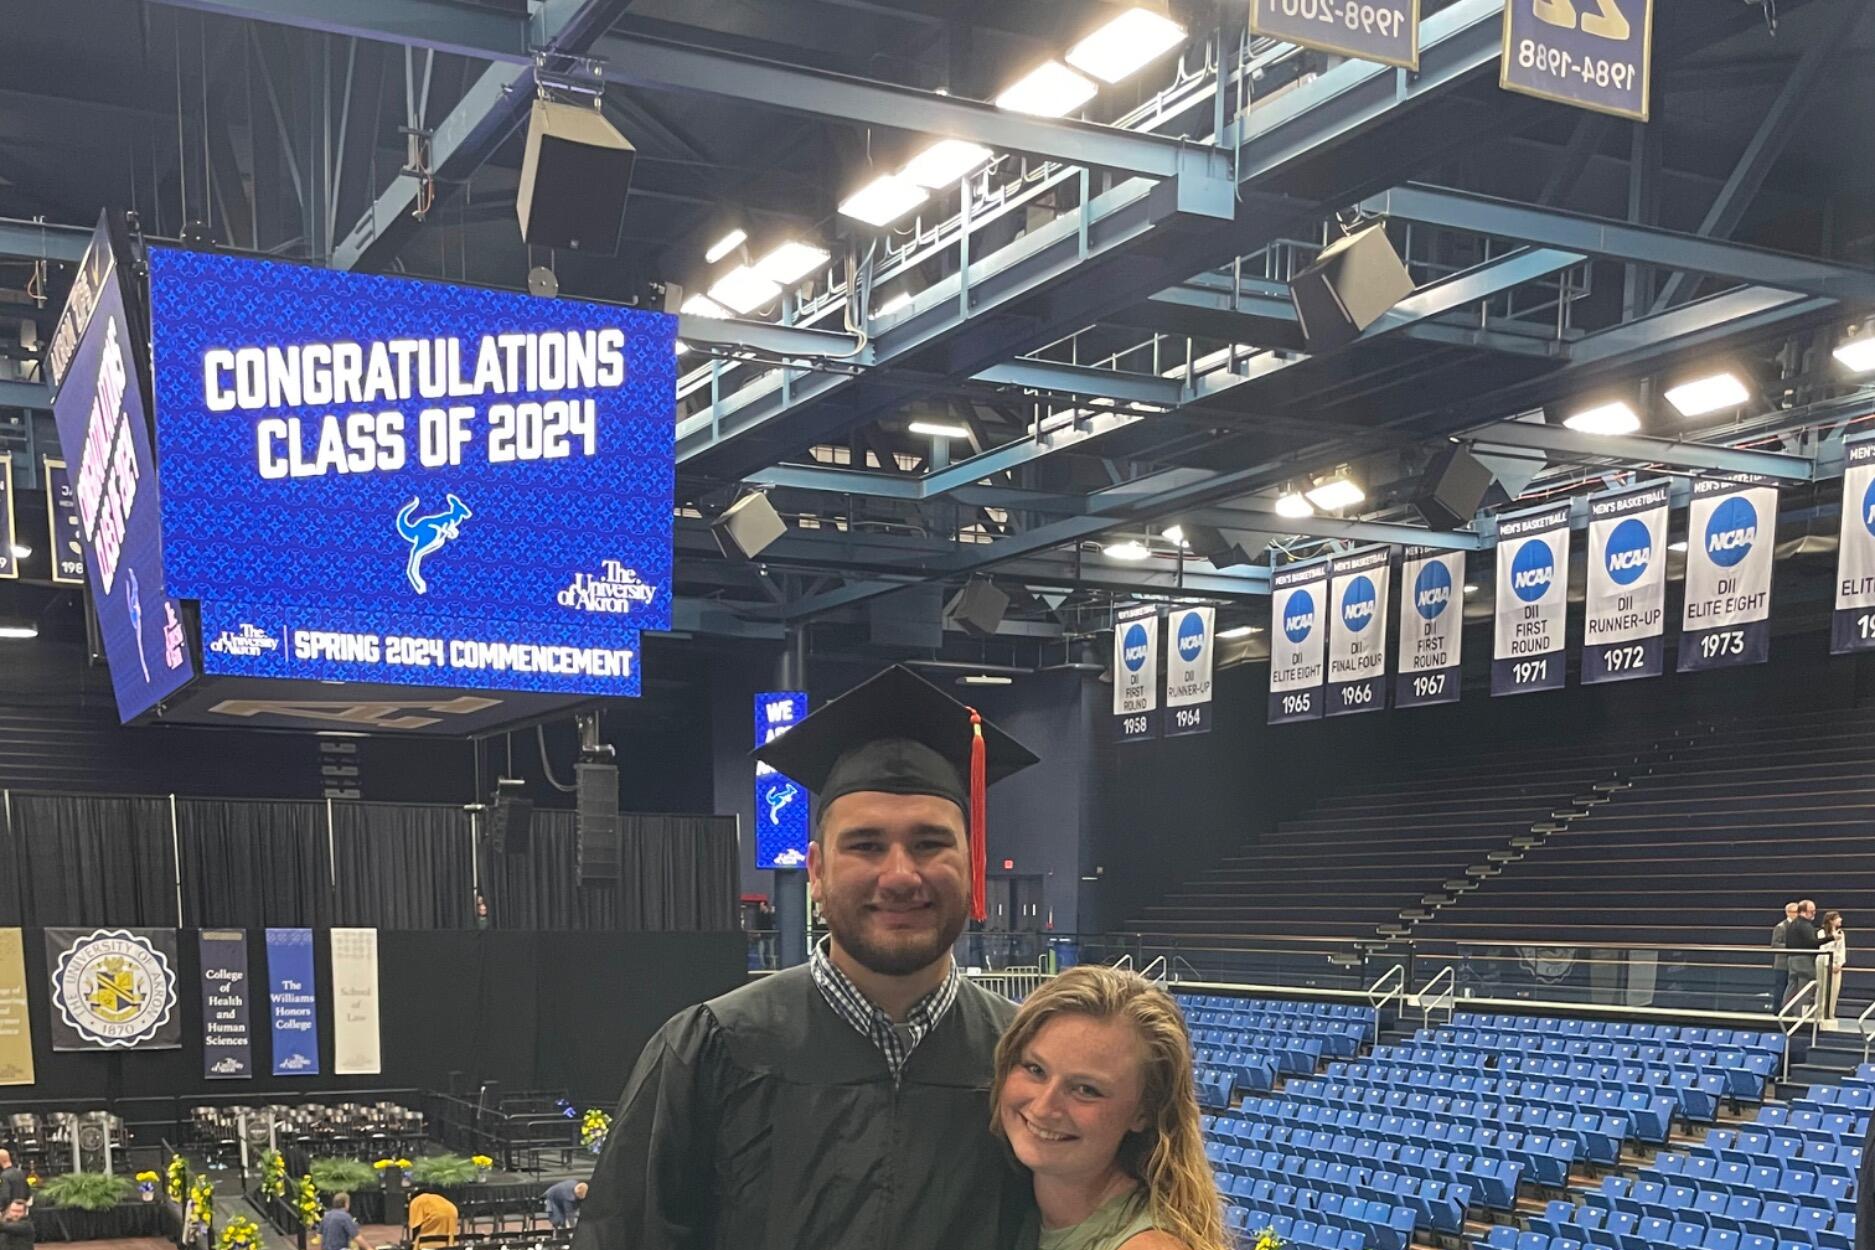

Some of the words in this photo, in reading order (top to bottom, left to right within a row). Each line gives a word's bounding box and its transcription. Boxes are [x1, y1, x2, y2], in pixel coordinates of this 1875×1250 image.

[204, 329, 625, 411] CONGRATULATIONS
[257, 411, 406, 479] CLASS
[419, 406, 476, 467] OF
[487, 399, 597, 463] 2024
[1694, 479, 1719, 493] MEN'S
[1593, 501, 1616, 515] MEN'S
[1616, 489, 1667, 512] BASKETBALL
[1500, 521, 1521, 536] MEN'S
[1522, 510, 1567, 531] BASKETBALL
[1708, 527, 1756, 553] NCAA
[1609, 547, 1650, 572] NCAA
[601, 559, 637, 584] The
[1515, 566, 1553, 589] NCAA
[574, 572, 657, 604] University
[1718, 578, 1736, 595] DII
[1841, 577, 1875, 596] ELIT
[557, 584, 578, 606] of
[576, 591, 630, 613] Akron
[1418, 586, 1450, 607] NCAA
[1618, 596, 1633, 611] DII
[1688, 599, 1721, 619] ELITE
[1725, 592, 1767, 613] EIGHT
[1344, 599, 1375, 620] NCAA
[1524, 604, 1539, 618] DII
[1286, 613, 1313, 631] NCAA
[1516, 619, 1548, 637] FIRST
[1589, 608, 1661, 634] RUNNER-UP
[240, 624, 266, 638] The
[1180, 634, 1204, 651] NCAA
[1417, 637, 1444, 652] FIRST
[1511, 636, 1550, 654] ROUND
[1701, 630, 1745, 658] 1973
[294, 630, 381, 663] SPRING
[385, 636, 445, 667] 2024
[449, 640, 634, 677] COMMENCEMENT
[1331, 658, 1356, 673] FINAL
[1357, 653, 1382, 670] FOUR
[1413, 652, 1447, 668] ROUND
[1604, 645, 1644, 671] 1972
[1273, 668, 1296, 683] ELITE
[1297, 664, 1322, 680] EIGHT
[1513, 659, 1547, 684] 1971
[1125, 686, 1144, 699] FIRST
[1168, 681, 1211, 698] RUNNER-UP
[1341, 684, 1372, 705] 1966
[1413, 674, 1445, 697] 1967
[765, 699, 794, 723] WE
[1123, 698, 1147, 711] ROUND
[1282, 693, 1311, 714] 1965
[1123, 716, 1147, 734] 1958
[1176, 708, 1200, 727] 1964
[66, 941, 133, 984] UNIVERSITY
[137, 951, 152, 964] OF
[205, 969, 243, 982] College
[281, 980, 302, 990] The
[147, 973, 165, 1018] AKRON
[219, 982, 231, 992] of
[67, 993, 86, 1018] THE
[208, 996, 243, 1006] Health
[270, 993, 315, 1003] Williams
[216, 1009, 236, 1020] and
[275, 1007, 311, 1017] Honors
[103, 1024, 135, 1036] 1870
[207, 1023, 246, 1033] Human
[275, 1020, 312, 1031] College
[205, 1035, 249, 1046] Sciences
